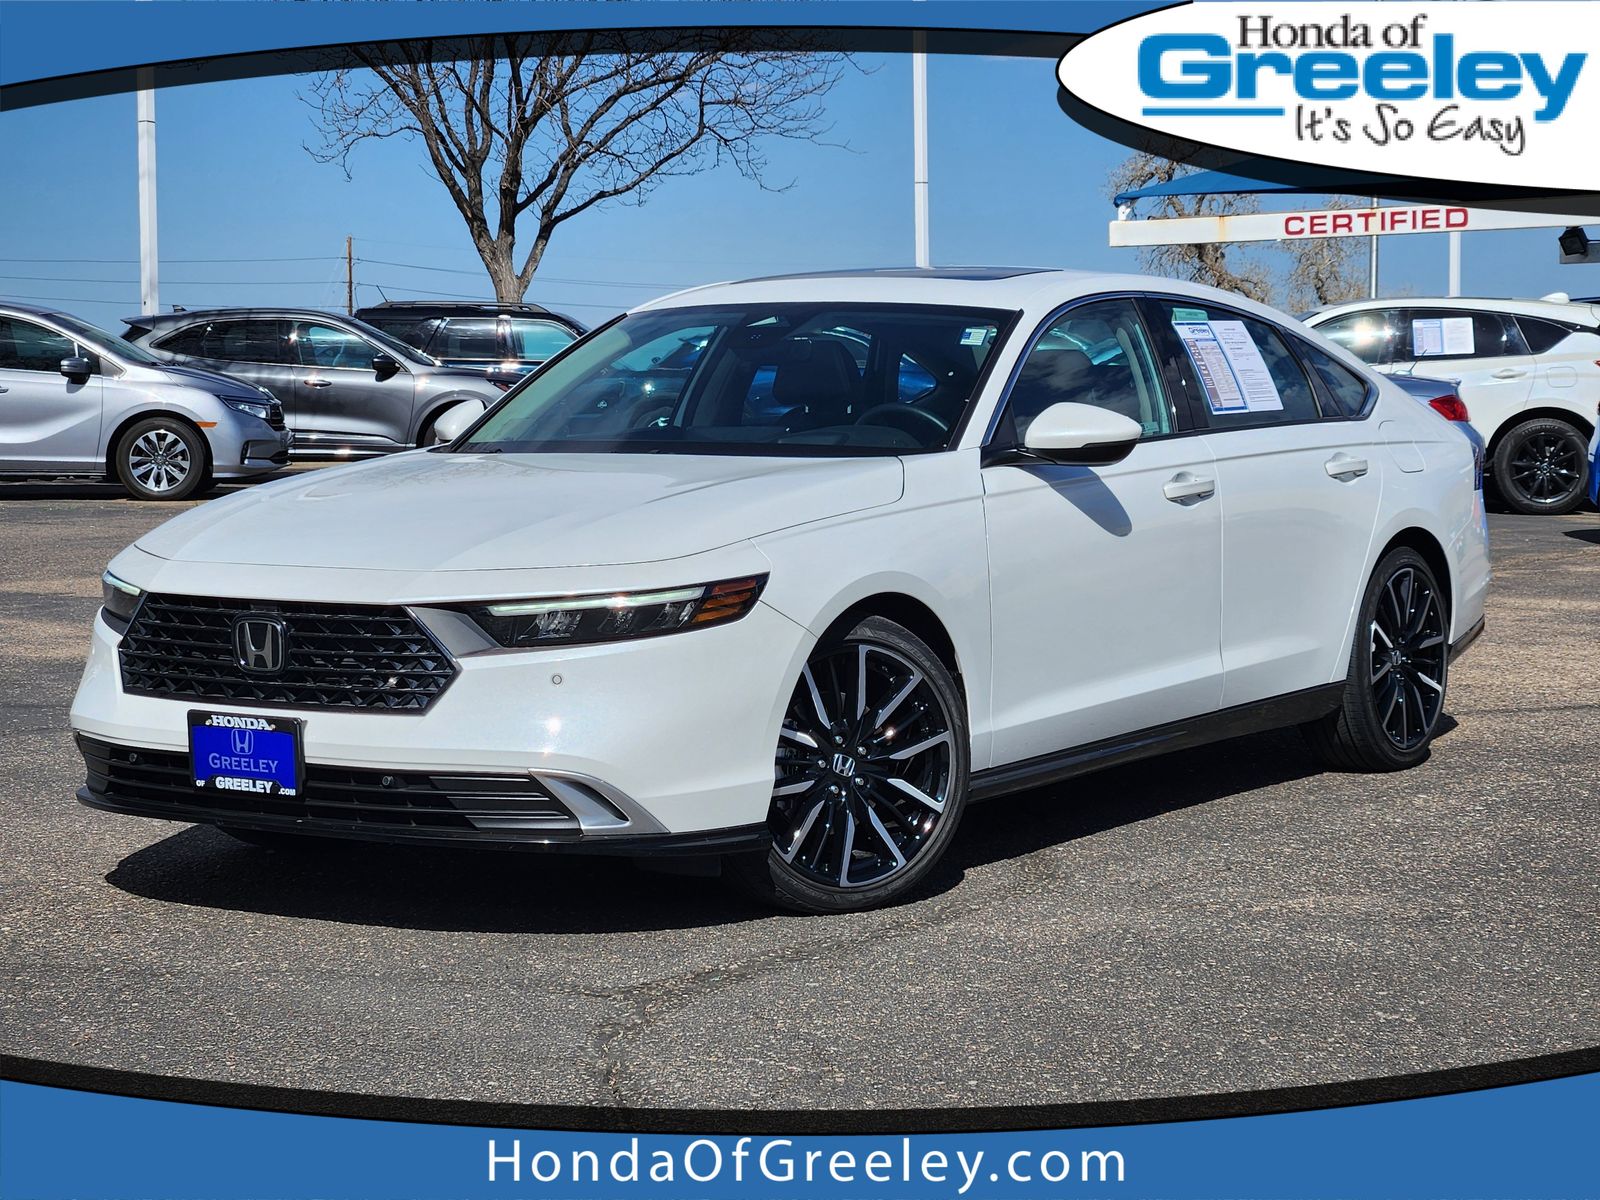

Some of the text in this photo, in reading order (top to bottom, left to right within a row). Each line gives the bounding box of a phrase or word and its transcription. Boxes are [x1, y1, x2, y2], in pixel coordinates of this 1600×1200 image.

[1284, 207, 1469, 236] CERTIFIED
[211, 715, 272, 731] HONDA
[209, 753, 278, 773] GREELEY
[215, 777, 272, 794] GREELEY
[278, 788, 296, 796] .COM
